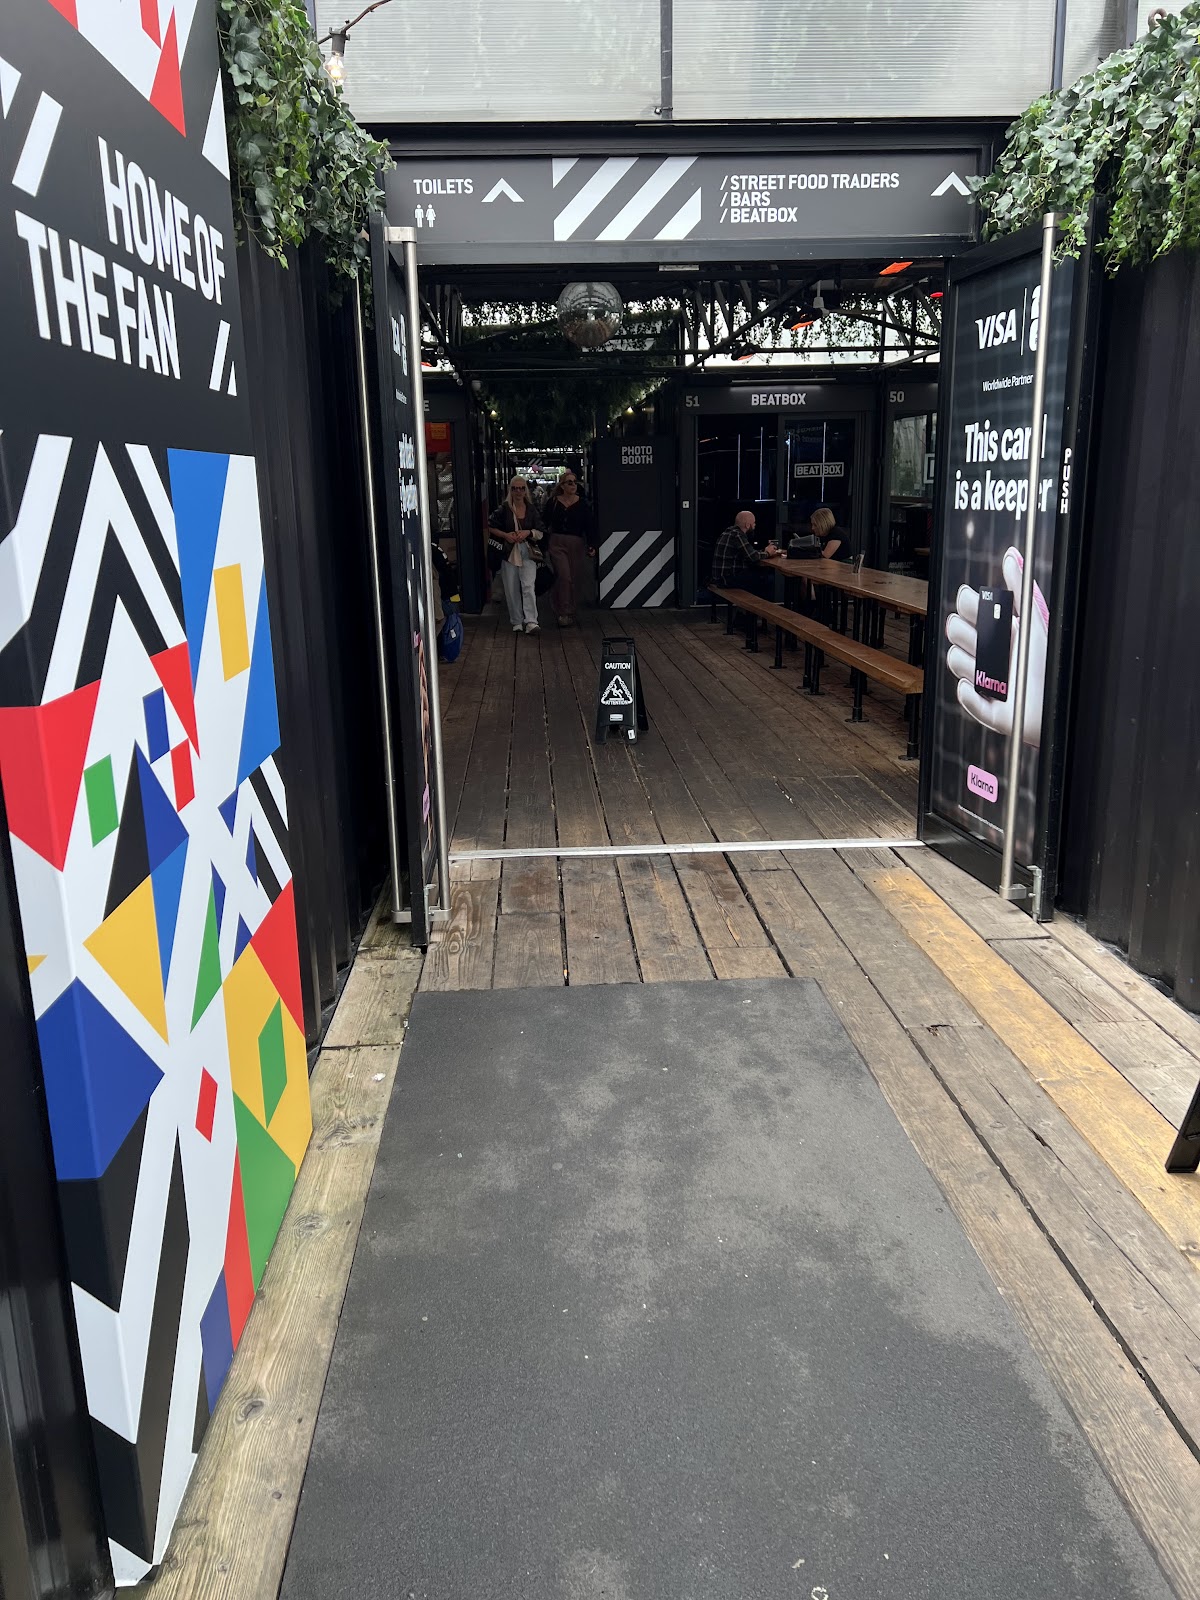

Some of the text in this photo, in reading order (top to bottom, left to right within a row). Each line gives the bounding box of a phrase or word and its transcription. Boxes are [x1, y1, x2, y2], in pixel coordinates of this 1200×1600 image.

[413, 178, 474, 195] TOILETS
[788, 174, 829, 189] FOOD
[831, 173, 900, 189] TRADERS
[98, 135, 226, 306] HOME OF
[15, 210, 181, 380] THE FAN
[975, 308, 1017, 350] VISA
[982, 374, 1034, 392] Worldwide Partner
[685, 396, 700, 408] 51
[751, 393, 807, 406] BEATBOX
[889, 391, 904, 403] 50
[964, 413, 1048, 463] This car
[621, 446, 653, 455] PHOTO
[621, 456, 653, 465] BOOTH
[796, 465, 820, 475] BEAT
[1060, 447, 1072, 514] PUSH
[954, 469, 969, 510] is
[970, 480, 982, 511] a
[975, 670, 1007, 695] Klarna
[970, 772, 994, 795] Klarna
